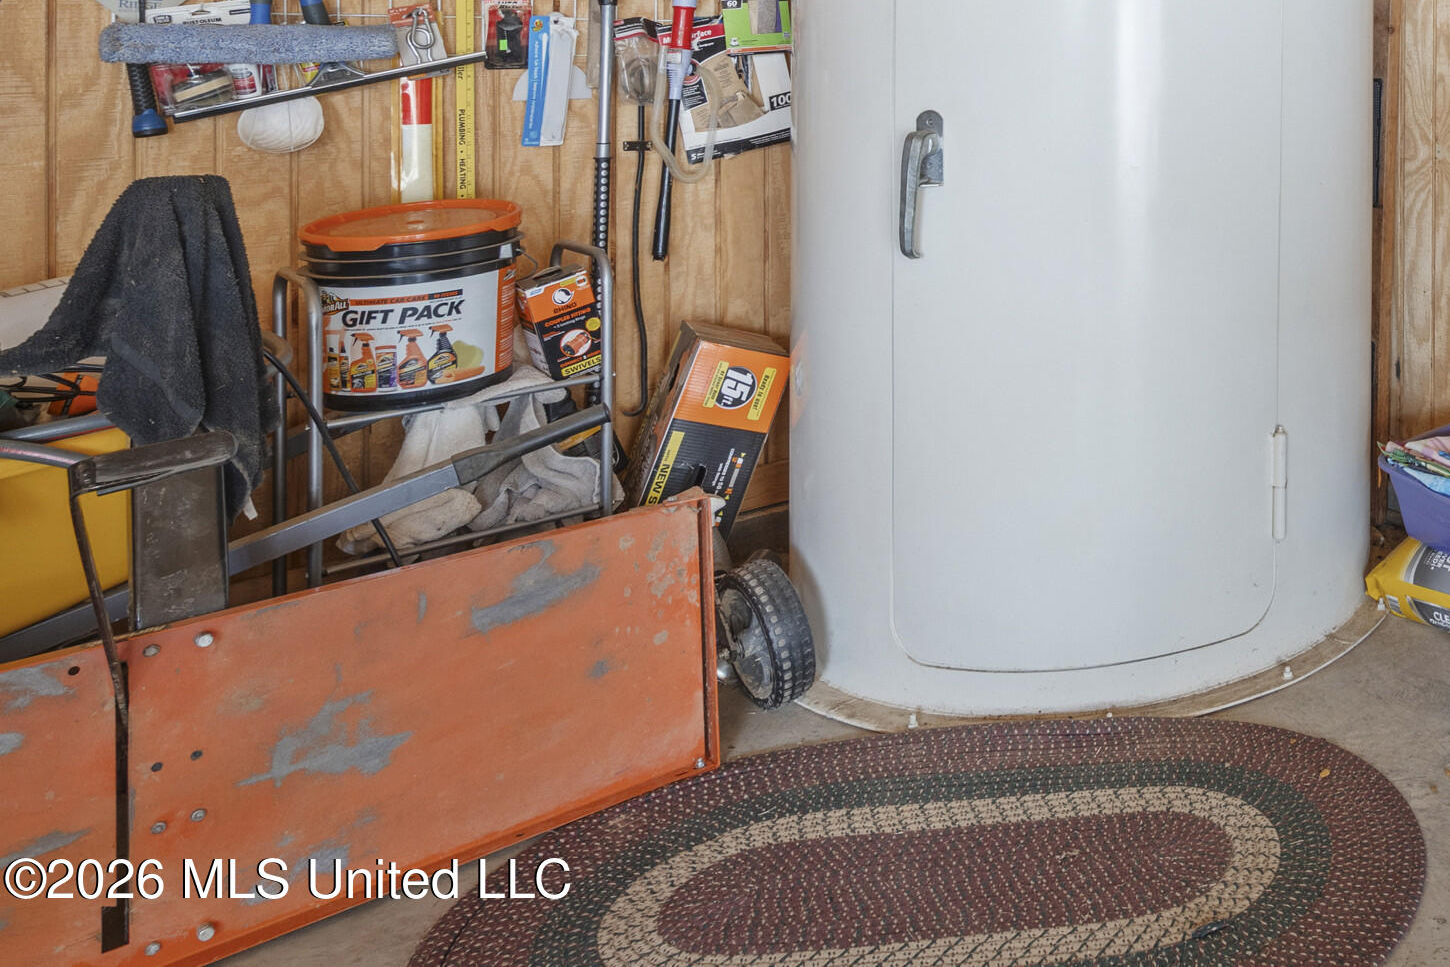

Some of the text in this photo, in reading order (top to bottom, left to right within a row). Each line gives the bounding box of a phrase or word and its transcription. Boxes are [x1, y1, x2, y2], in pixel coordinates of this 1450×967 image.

[726, 0, 738, 8] 60
[770, 94, 791, 107] 100
[458, 108, 467, 190] PLUMBING HEATING
[355, 298, 388, 306] ULTIMATE
[407, 295, 427, 303] CARE
[553, 301, 577, 314] RHINO
[341, 308, 395, 329] GIFT
[398, 299, 466, 326] PACK
[564, 356, 601, 375] SWIVELS
[720, 368, 754, 403] 15
[651, 462, 671, 494] NEW
